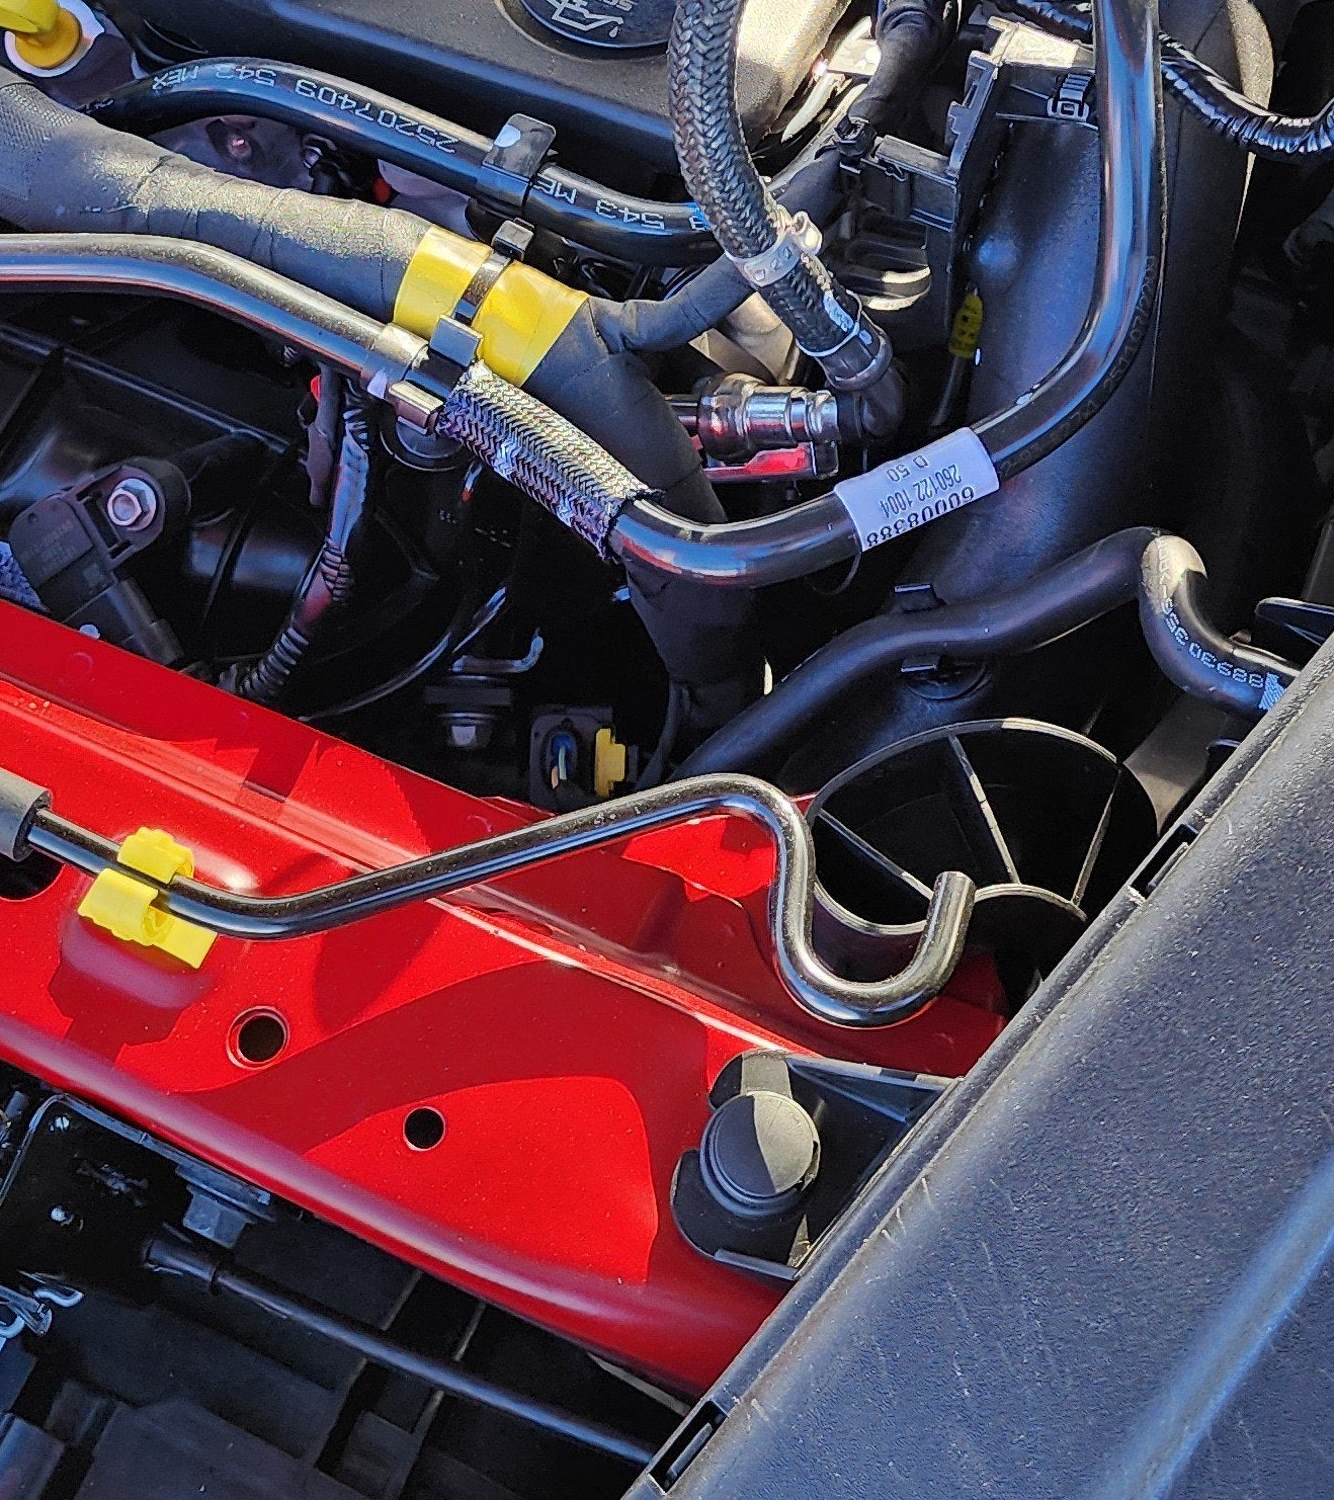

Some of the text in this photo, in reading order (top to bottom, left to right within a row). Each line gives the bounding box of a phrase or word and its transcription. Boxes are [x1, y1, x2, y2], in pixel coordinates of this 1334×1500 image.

[151, 63, 201, 90] MEX
[294, 78, 459, 155] 25207409
[534, 175, 579, 206] ME
[594, 199, 666, 233] 543
[885, 464, 911, 484] 50
[879, 463, 964, 519] 260122 1004
